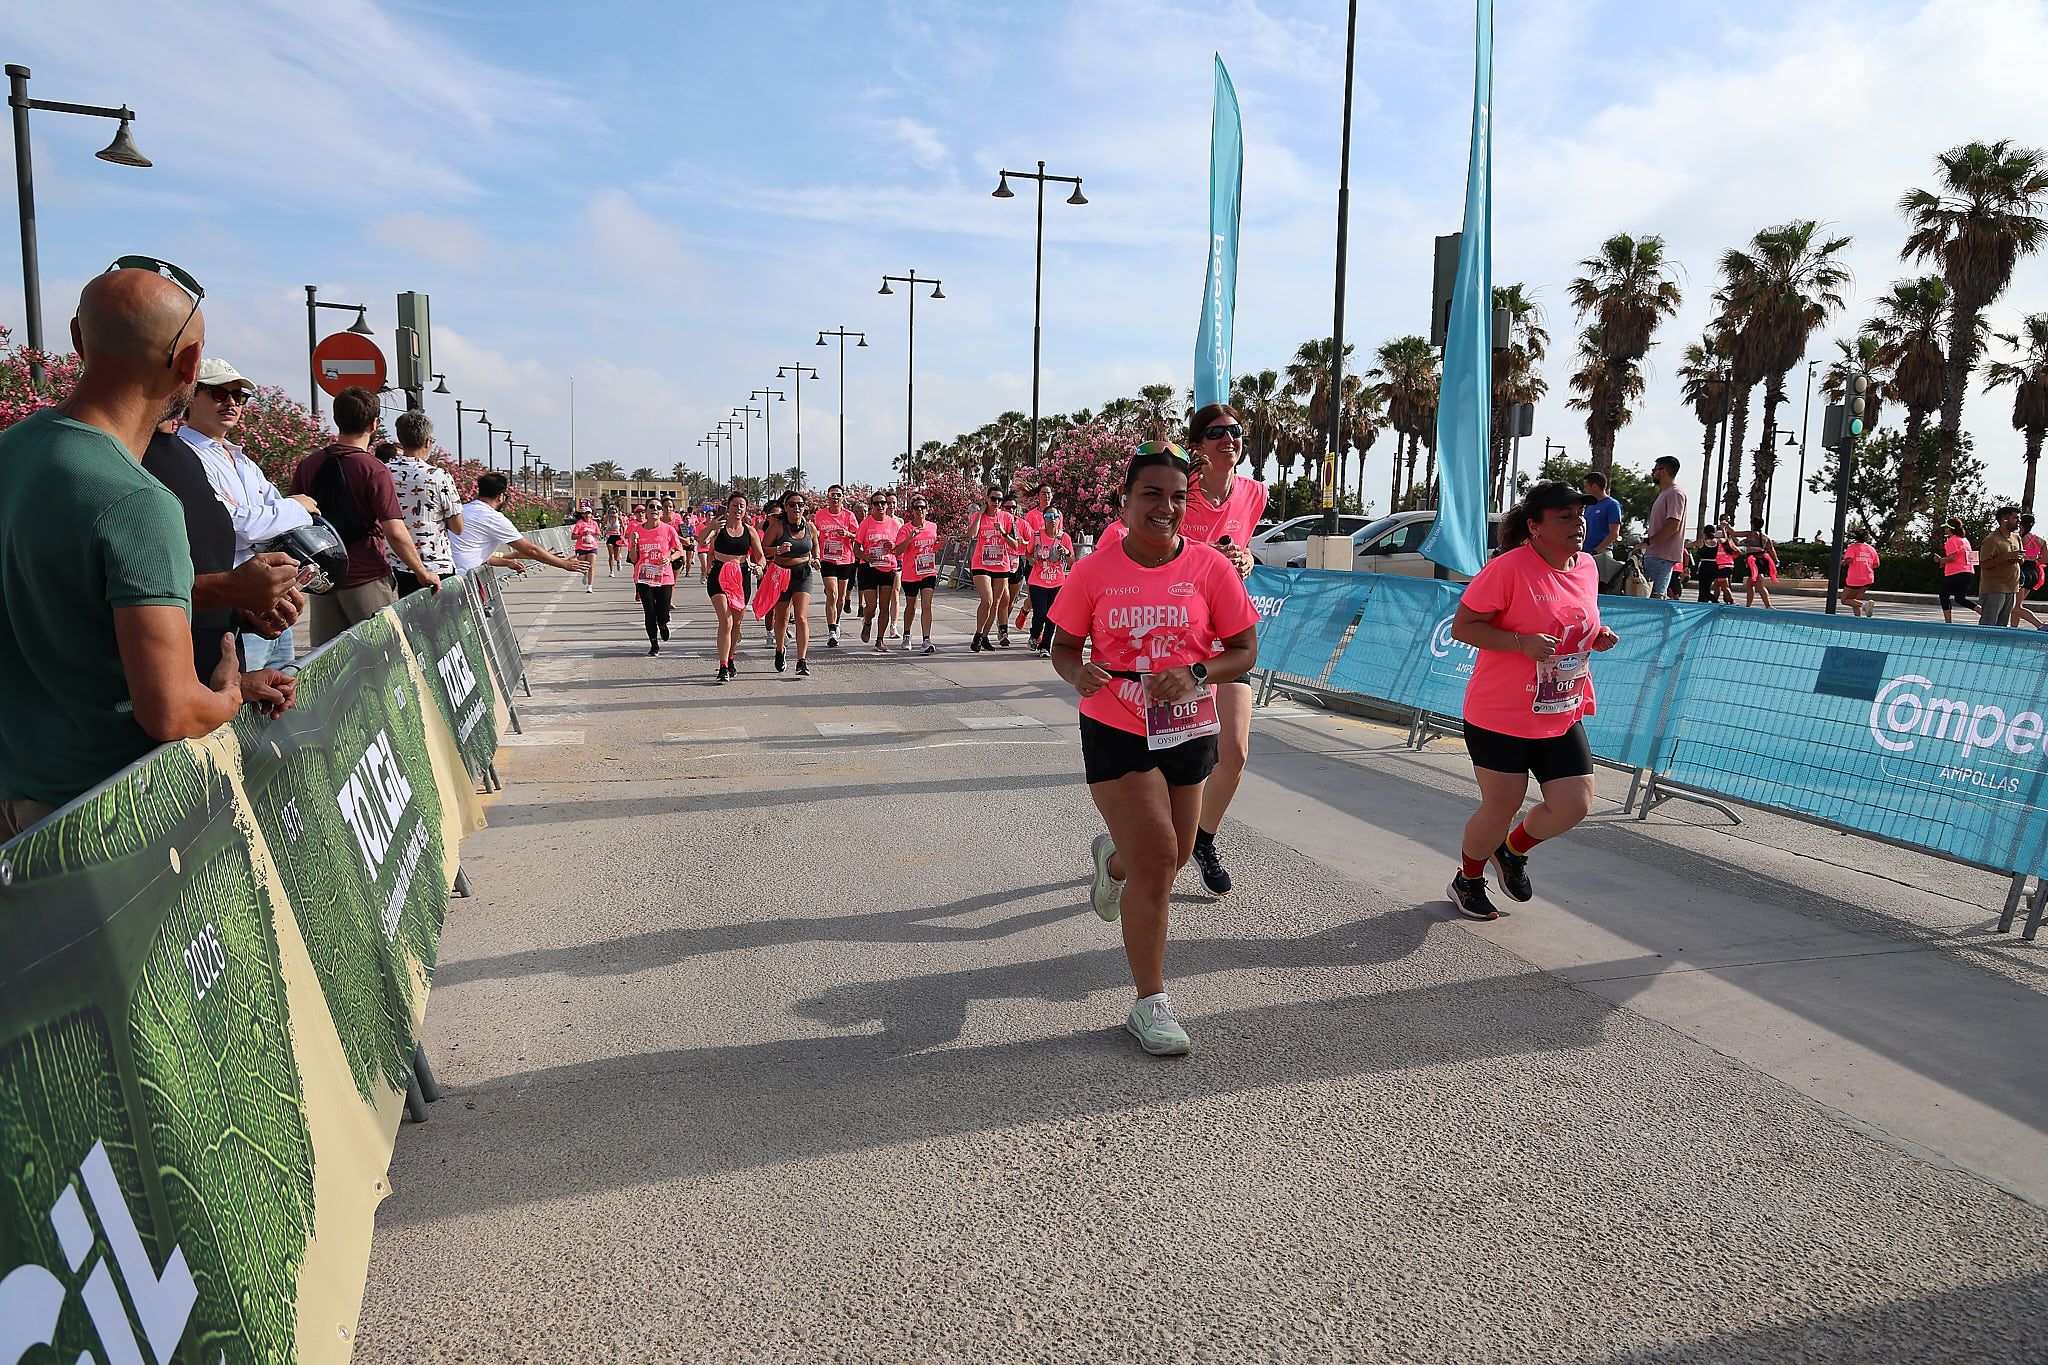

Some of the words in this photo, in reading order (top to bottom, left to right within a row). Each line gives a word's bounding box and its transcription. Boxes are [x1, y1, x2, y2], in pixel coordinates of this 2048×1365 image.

[1182, 523, 1208, 532] OYSHO
[1105, 585, 1140, 596] OYSHO
[1557, 680, 1575, 692] 016
[1173, 701, 1198, 718] 016
[1870, 674, 2048, 758] Compe
[1939, 764, 2020, 793] AMPOLLAS
[281, 796, 304, 845] 1975
[183, 922, 226, 1001] 2026
